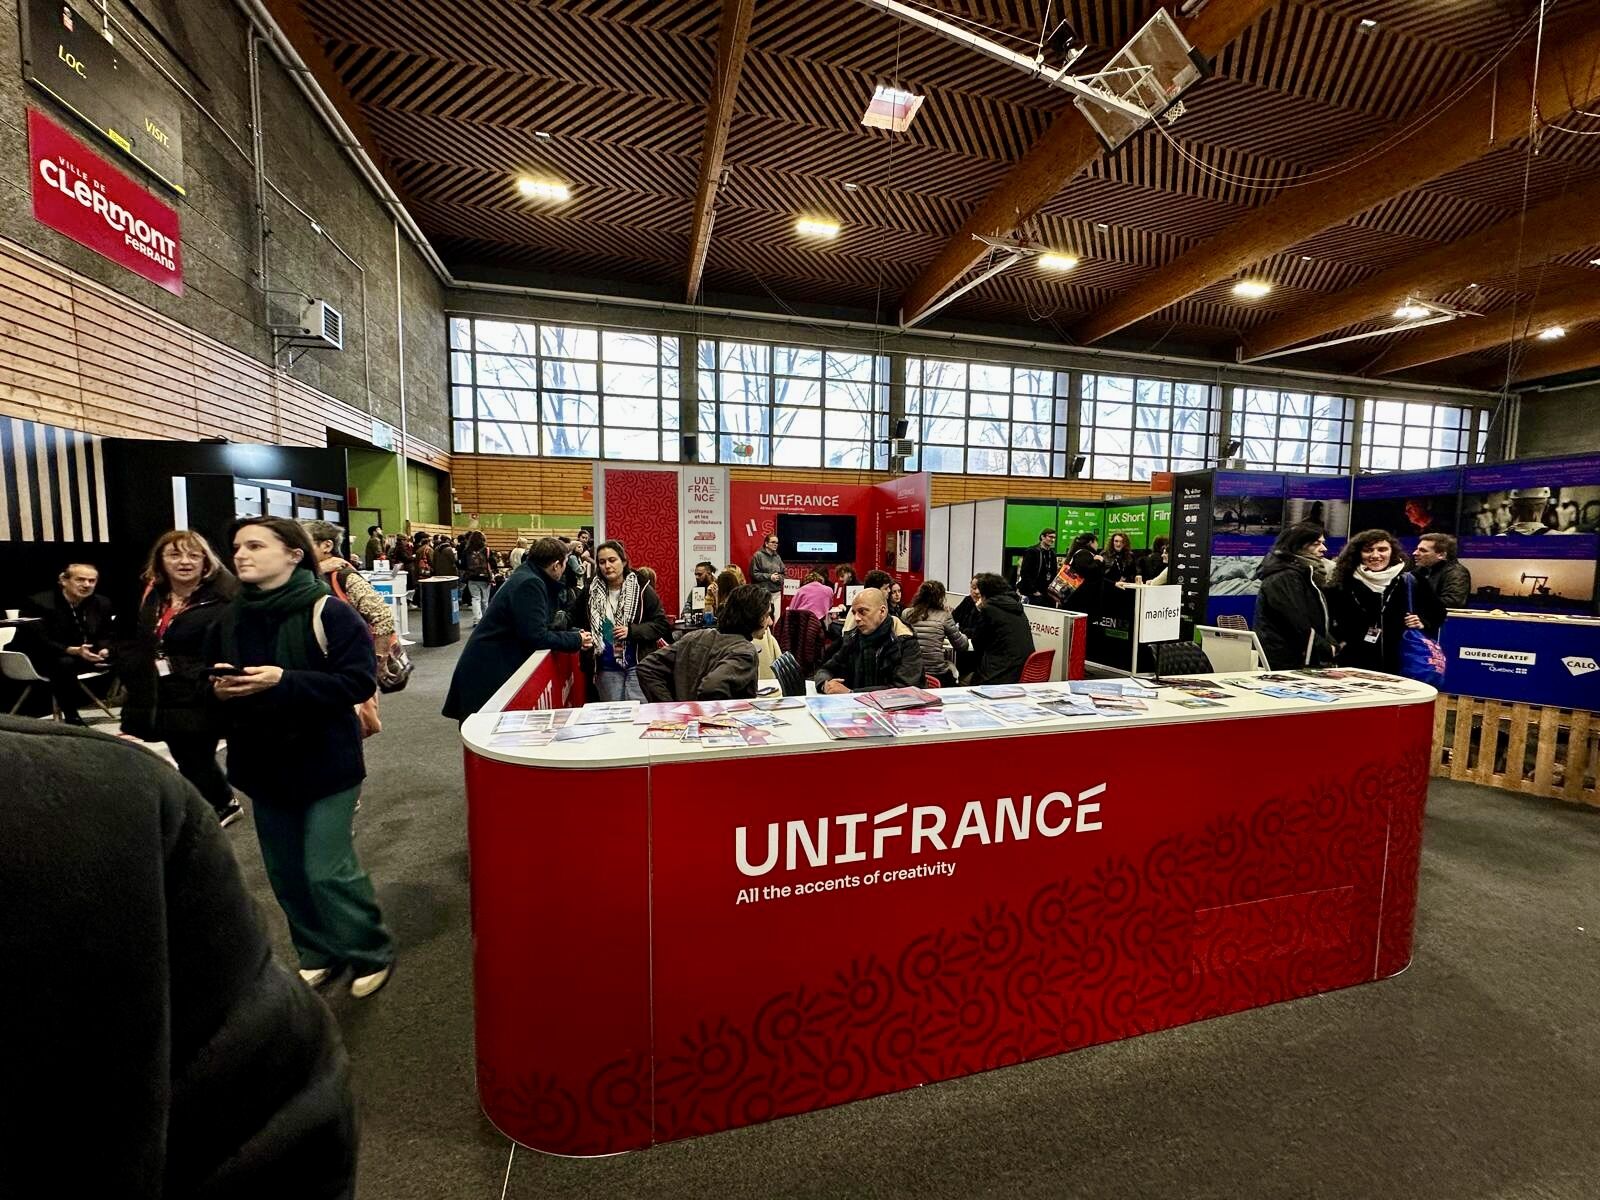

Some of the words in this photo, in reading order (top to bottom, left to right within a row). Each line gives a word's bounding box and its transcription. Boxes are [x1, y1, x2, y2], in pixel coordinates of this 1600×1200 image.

[58, 44, 87, 79] LOC.
[145, 117, 170, 149] VISIT.
[58, 155, 89, 181] VILLE
[93, 179, 107, 194] DE
[694, 476, 715, 485] UNI
[687, 485, 709, 494] FRA
[1108, 512, 1121, 524] UK
[1121, 511, 1145, 524] Short
[1145, 606, 1180, 620] manifest
[1566, 660, 1597, 670] CALQ
[735, 887, 759, 905] All
[763, 884, 792, 899] the
[794, 873, 861, 896] accents
[863, 870, 881, 886] of
[882, 861, 957, 882] creativity
